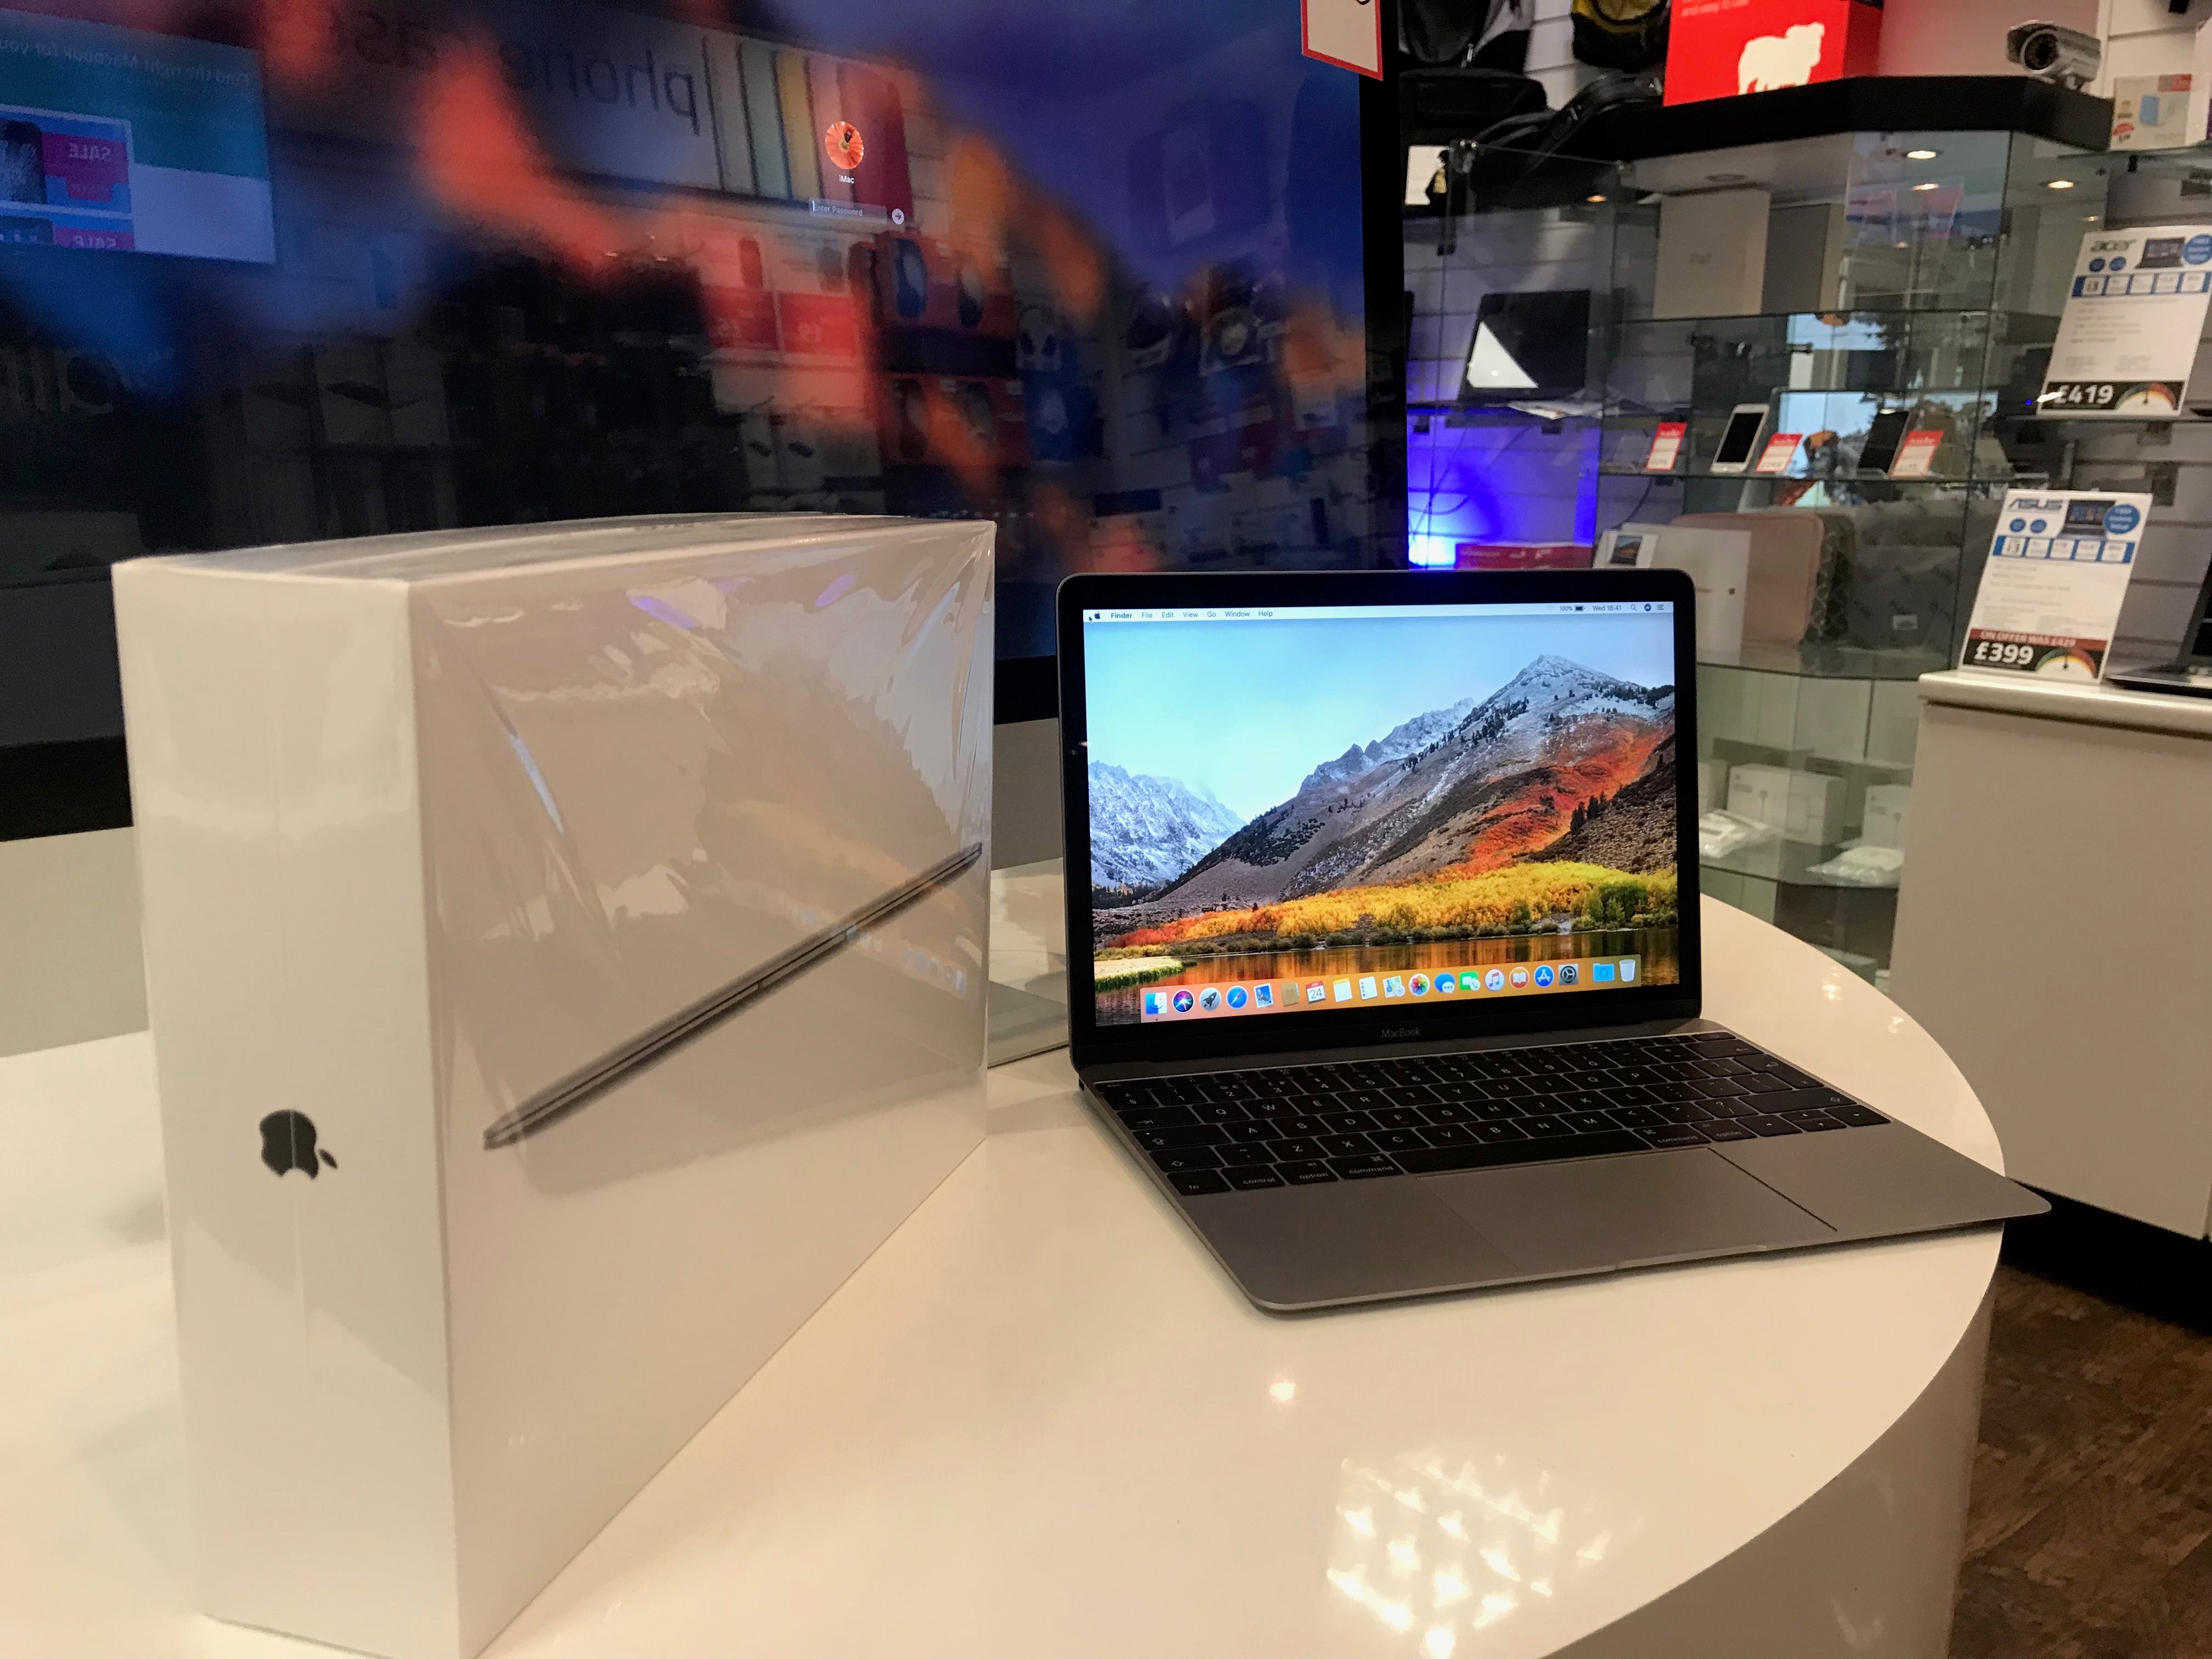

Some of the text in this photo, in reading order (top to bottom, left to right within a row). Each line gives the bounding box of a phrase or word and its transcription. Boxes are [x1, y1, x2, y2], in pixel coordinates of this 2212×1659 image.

[838, 174, 855, 184] iMac
[832, 205, 864, 216] Password
[2053, 384, 2114, 404] £419
[2008, 498, 2063, 510] ASUS
[1974, 640, 2035, 665] £399
[1310, 988, 1322, 999] 24
[1381, 1027, 1421, 1038] MacBook
[1348, 1165, 1393, 1174] command
